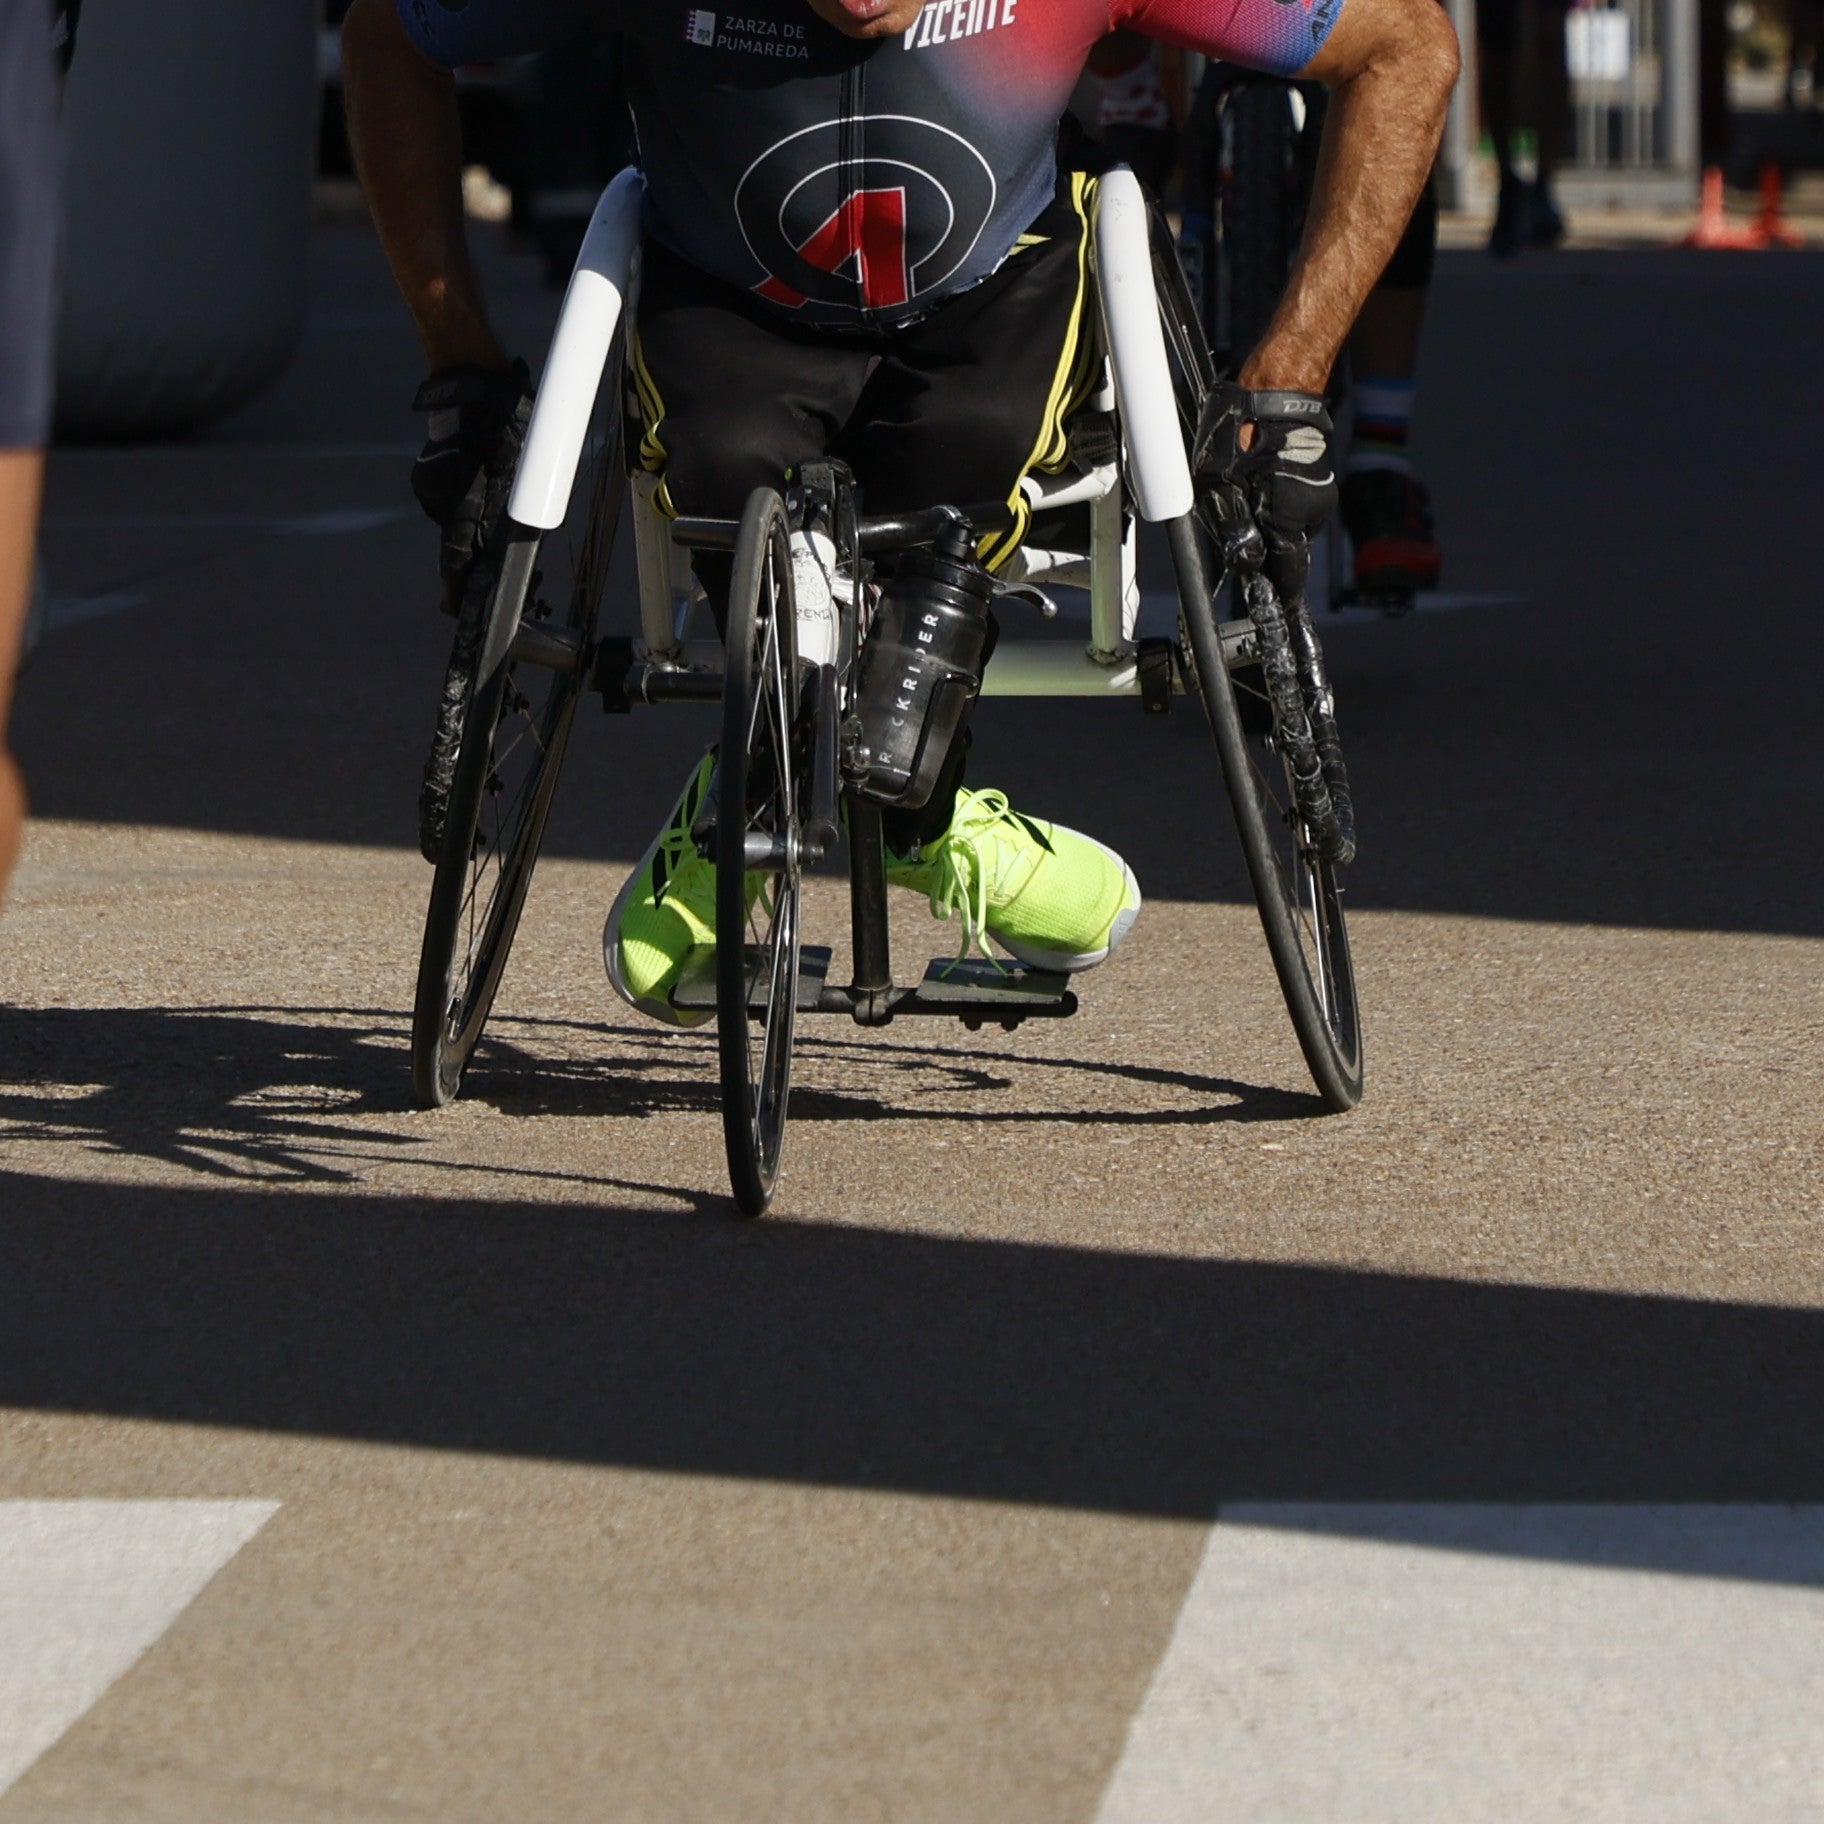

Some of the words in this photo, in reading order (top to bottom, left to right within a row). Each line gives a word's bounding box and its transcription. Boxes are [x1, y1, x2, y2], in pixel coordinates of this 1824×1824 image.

[724, 16, 778, 37] ZARZA
[783, 24, 806, 40] DE
[717, 34, 809, 59] PUMAREDA
[878, 613, 940, 764] RCKRIDER
